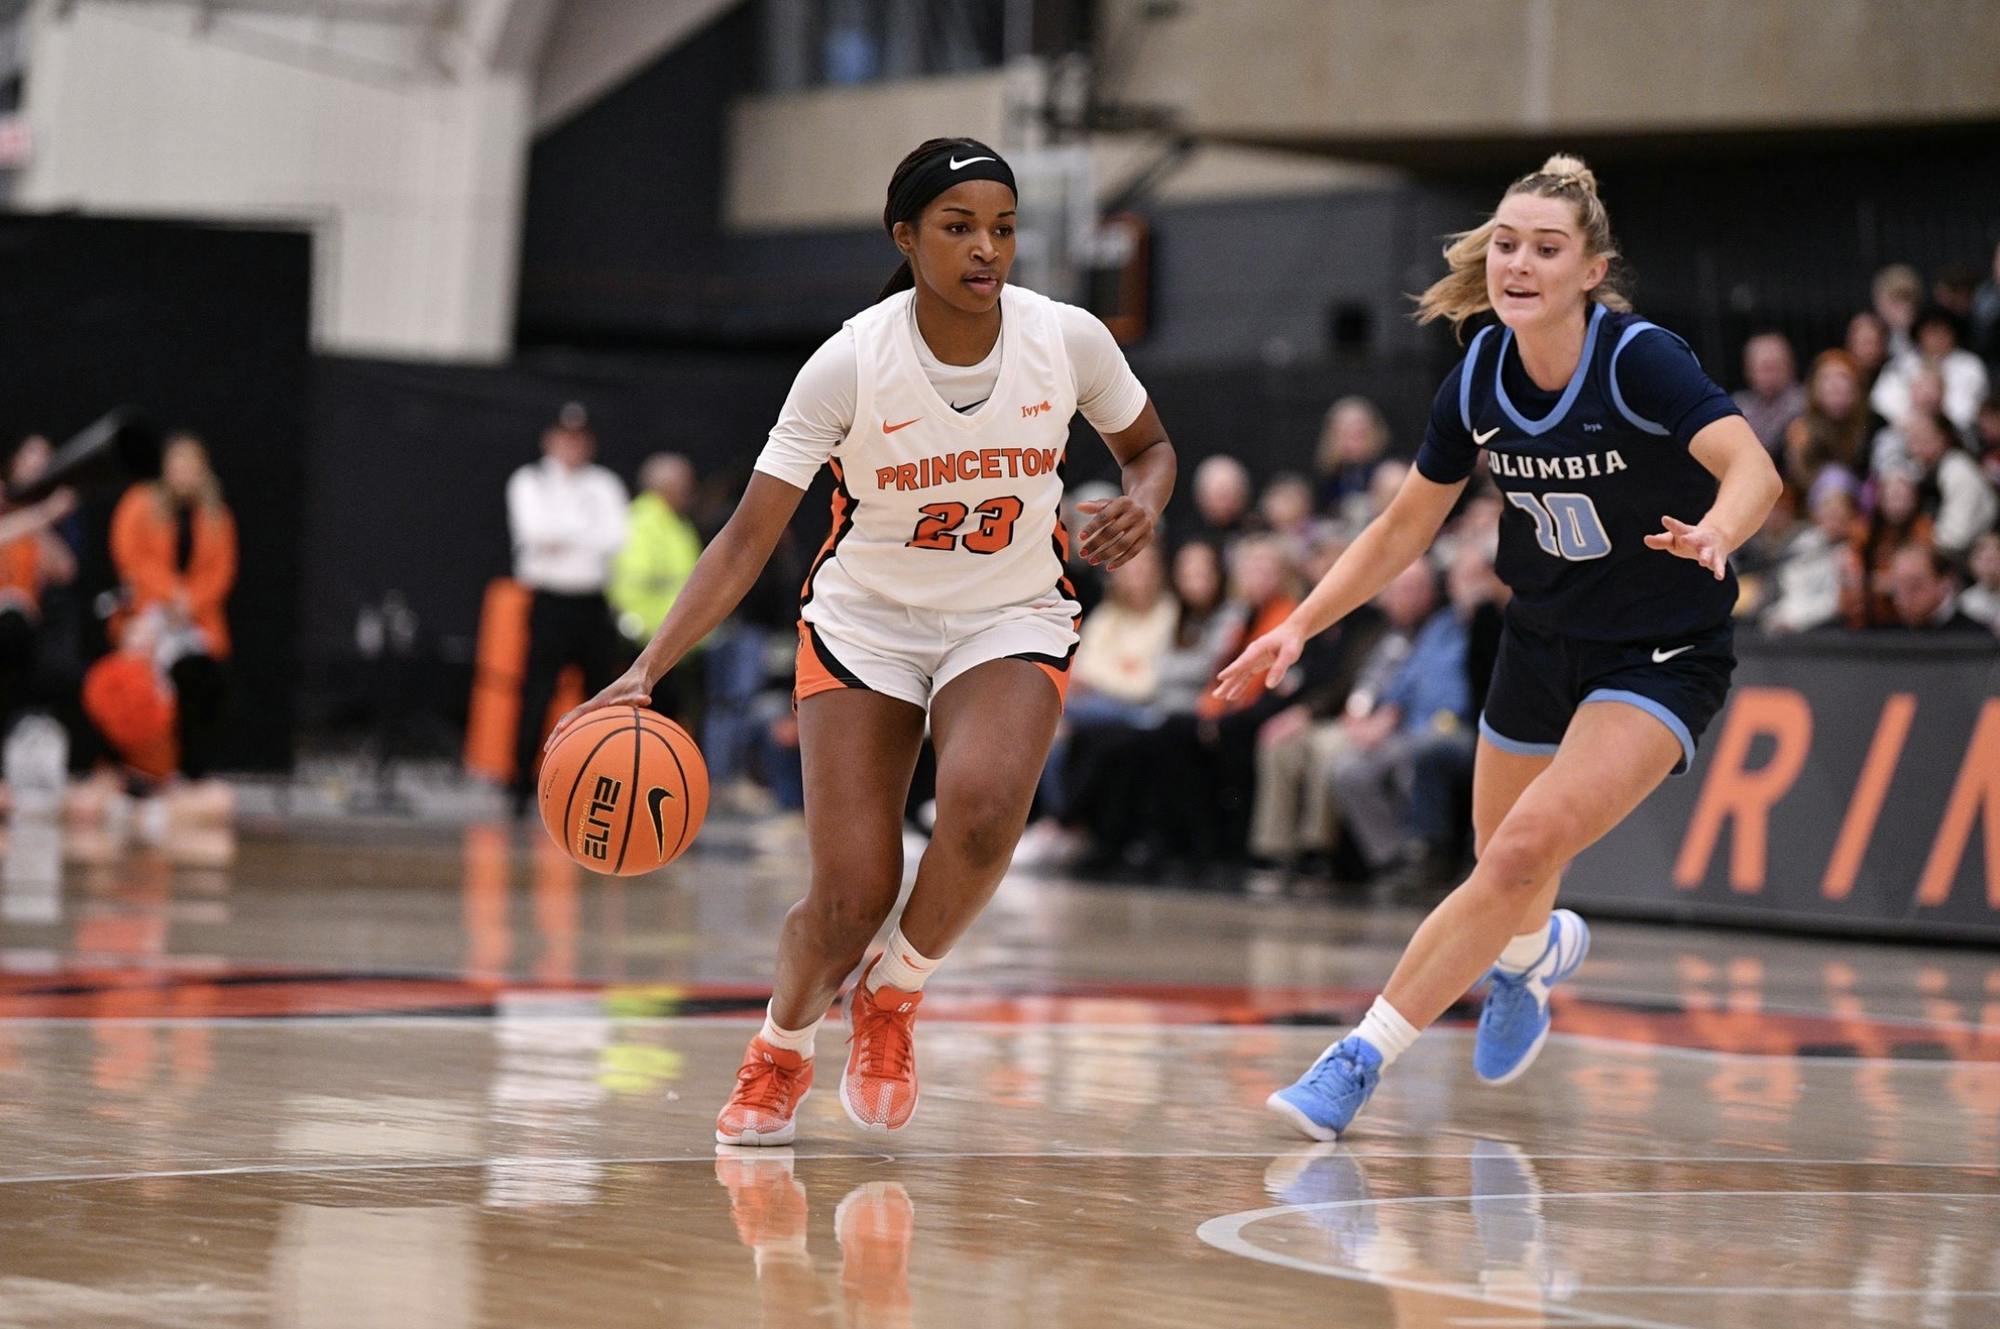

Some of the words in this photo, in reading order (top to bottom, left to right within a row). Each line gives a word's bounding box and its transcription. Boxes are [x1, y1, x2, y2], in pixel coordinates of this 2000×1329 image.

[1021, 404, 1040, 418] Ivy
[876, 448, 1057, 491] PRINCETON
[1488, 450, 1627, 480] OLUMBIA
[905, 496, 1024, 555] 23
[1506, 491, 1612, 561] 10
[584, 776, 622, 860] ELITE
[1672, 685, 2000, 909] RIN
